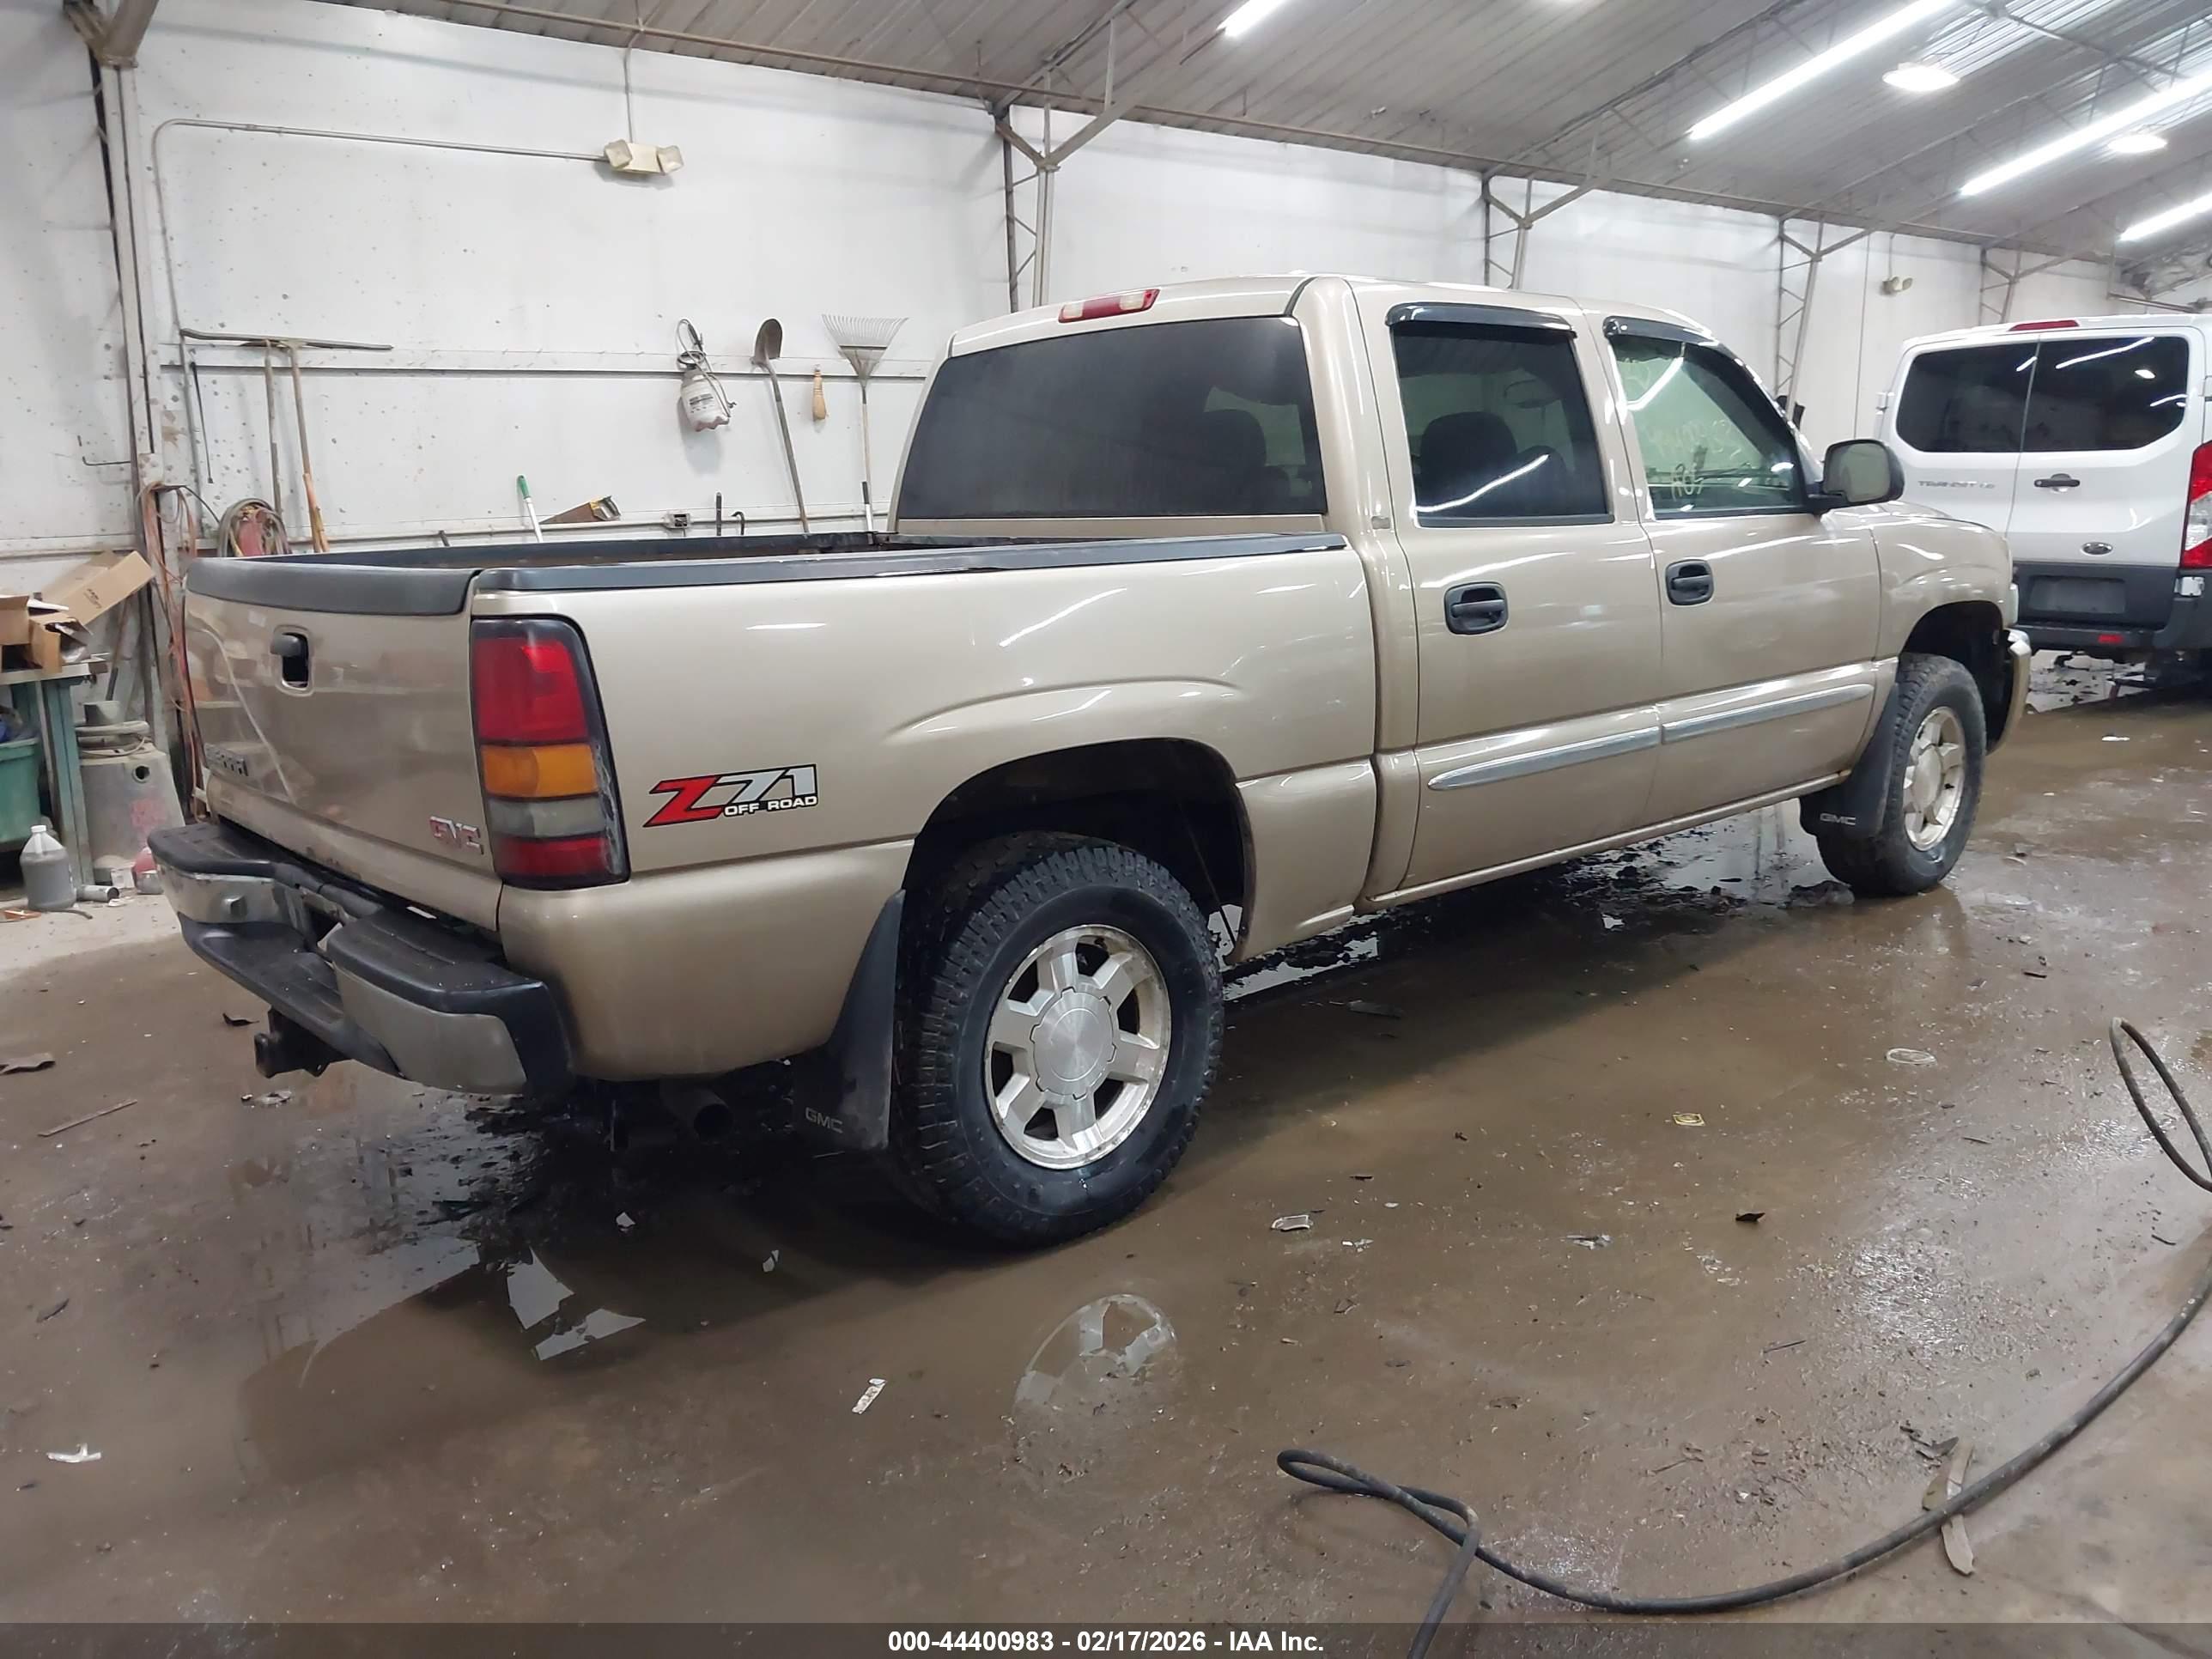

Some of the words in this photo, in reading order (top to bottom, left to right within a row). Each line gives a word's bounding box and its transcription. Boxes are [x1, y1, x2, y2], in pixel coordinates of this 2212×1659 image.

[642, 764, 818, 827] Z71
[724, 802, 760, 817] OFF
[767, 796, 817, 811] ROAD
[1820, 812, 1856, 826] GMC
[428, 816, 483, 853] GMC
[805, 1107, 843, 1133] GMC
